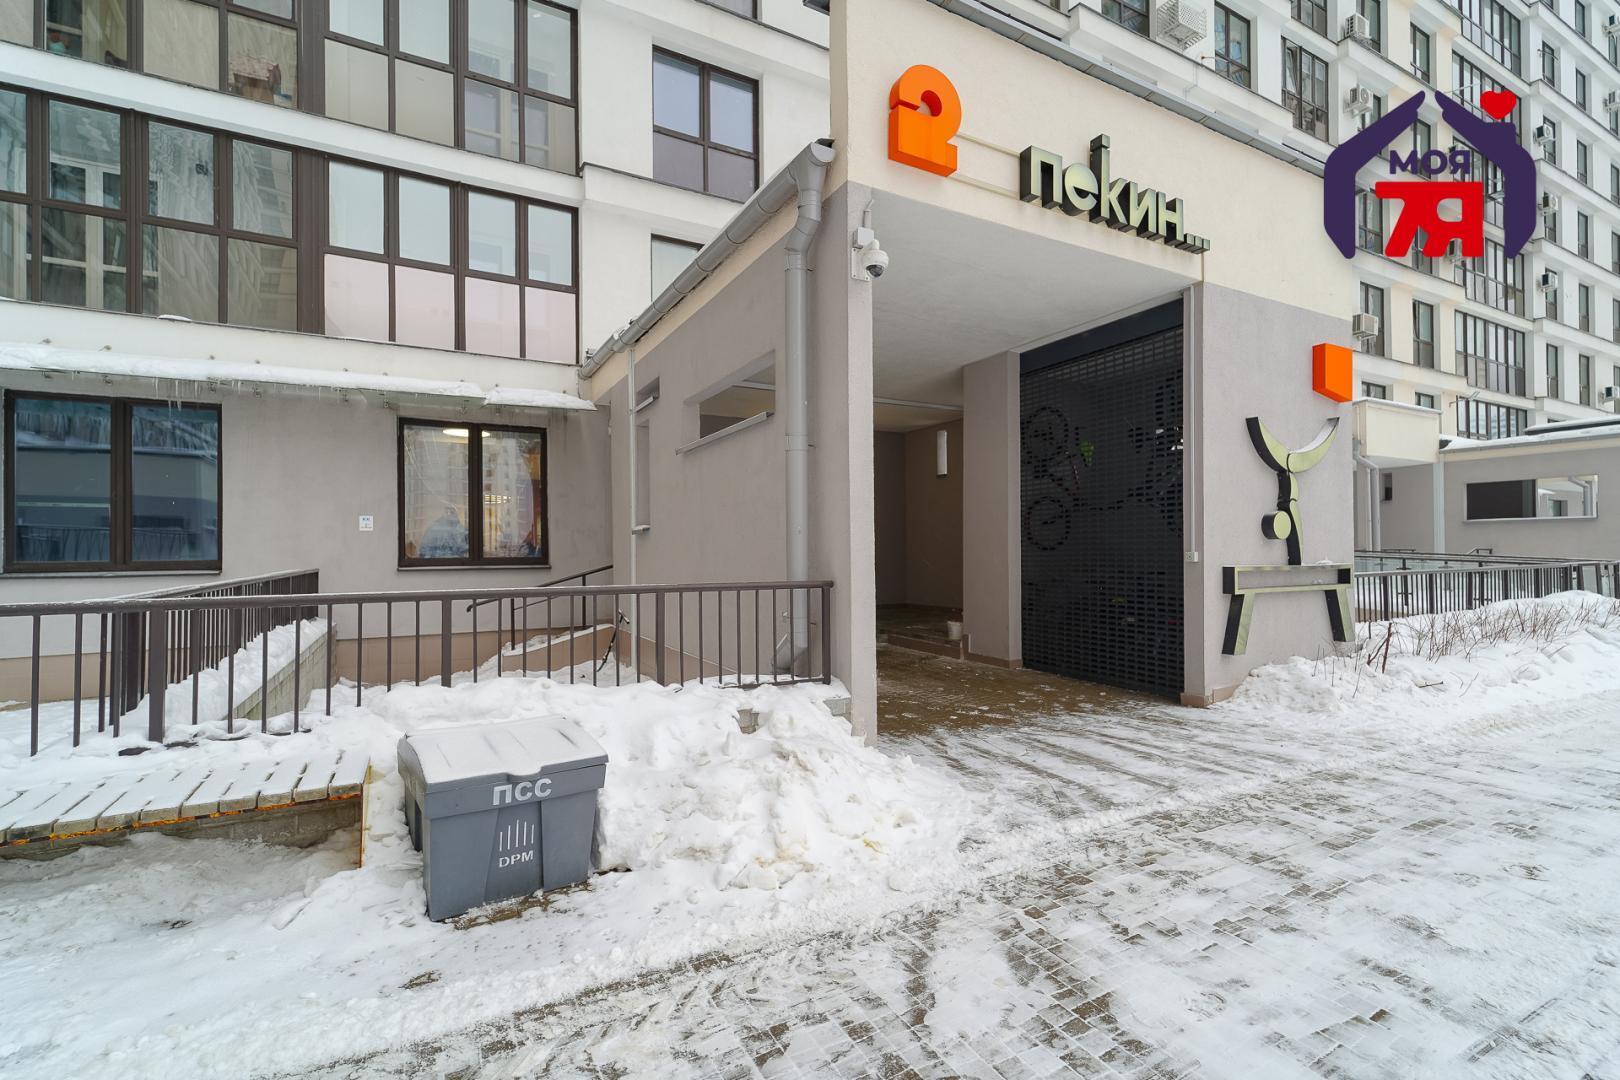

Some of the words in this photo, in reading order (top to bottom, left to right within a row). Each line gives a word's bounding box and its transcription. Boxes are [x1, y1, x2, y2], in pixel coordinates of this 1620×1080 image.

[888, 64, 962, 177] 2
[492, 778, 552, 806] ПСС
[499, 850, 534, 867] DPM
